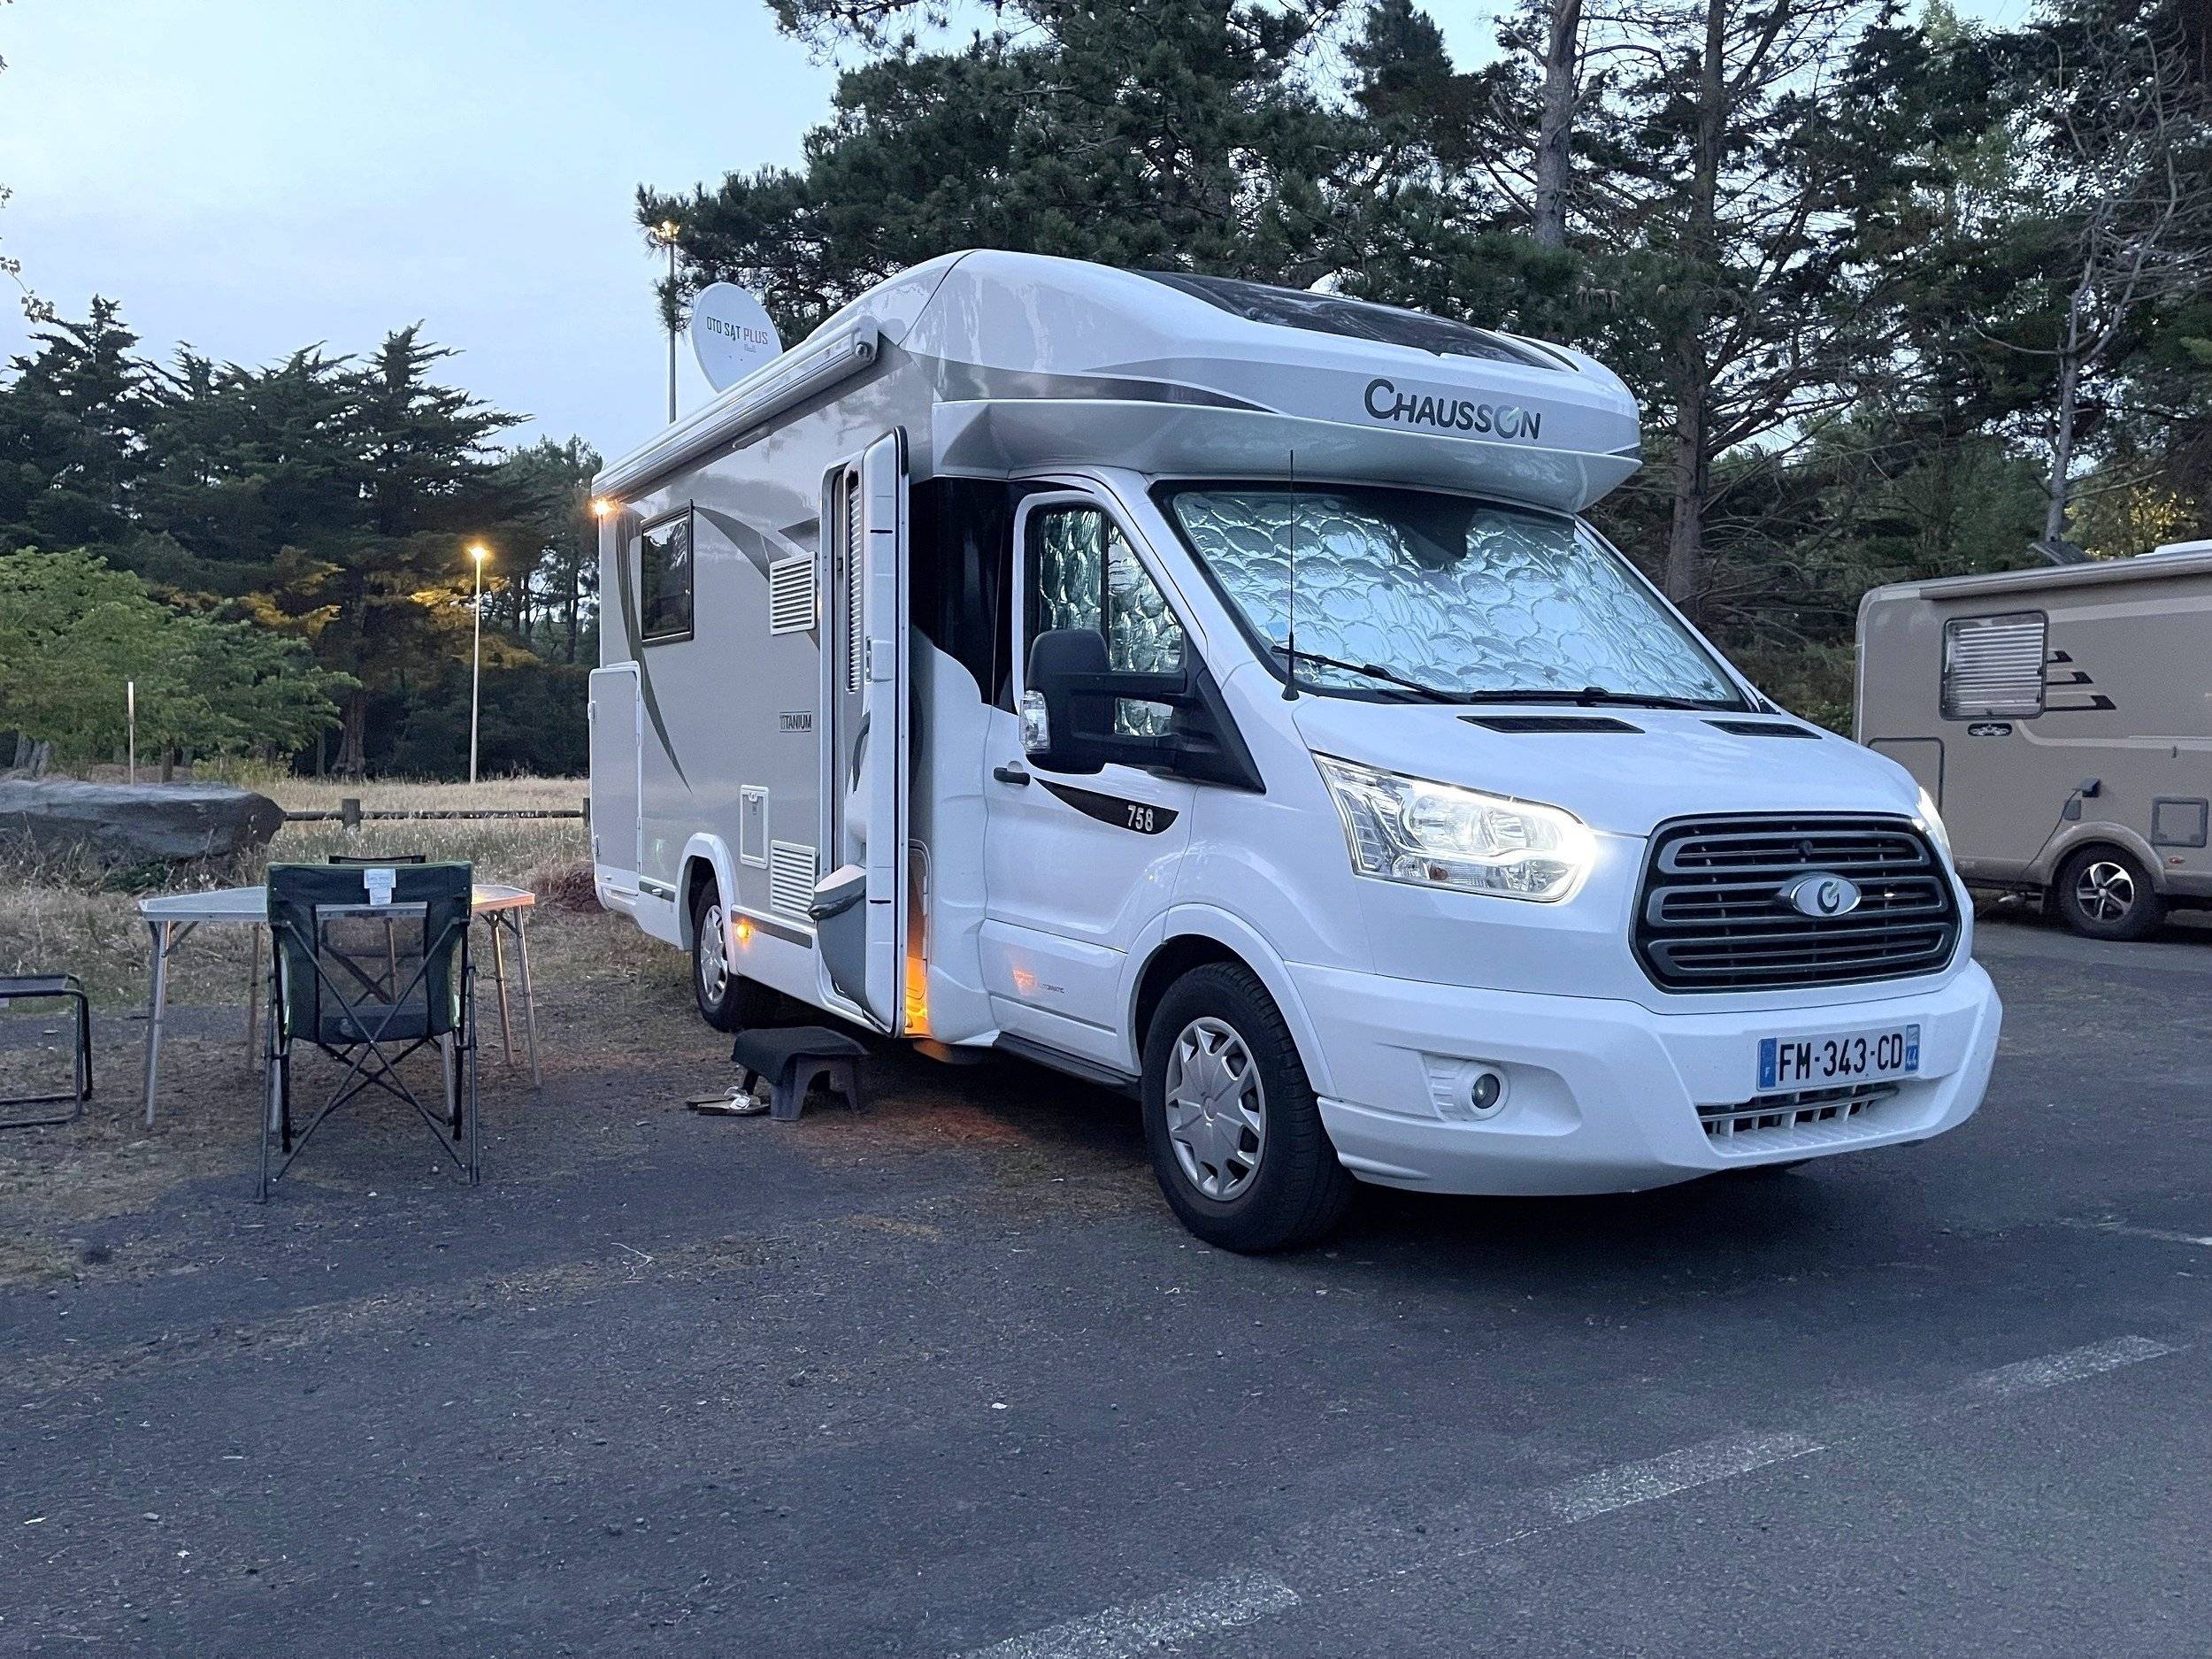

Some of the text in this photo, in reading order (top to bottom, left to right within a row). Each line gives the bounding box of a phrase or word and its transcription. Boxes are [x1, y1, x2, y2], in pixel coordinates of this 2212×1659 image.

[724, 322, 741, 339] SAT
[743, 327, 768, 345] PLUS
[1364, 378, 1541, 440] CHAUSSON
[780, 714, 812, 730] TITANIUM
[1127, 804, 1154, 832] 758
[1778, 1033, 1904, 1081] FM-343-CD
[1906, 1048, 1917, 1066] 44
